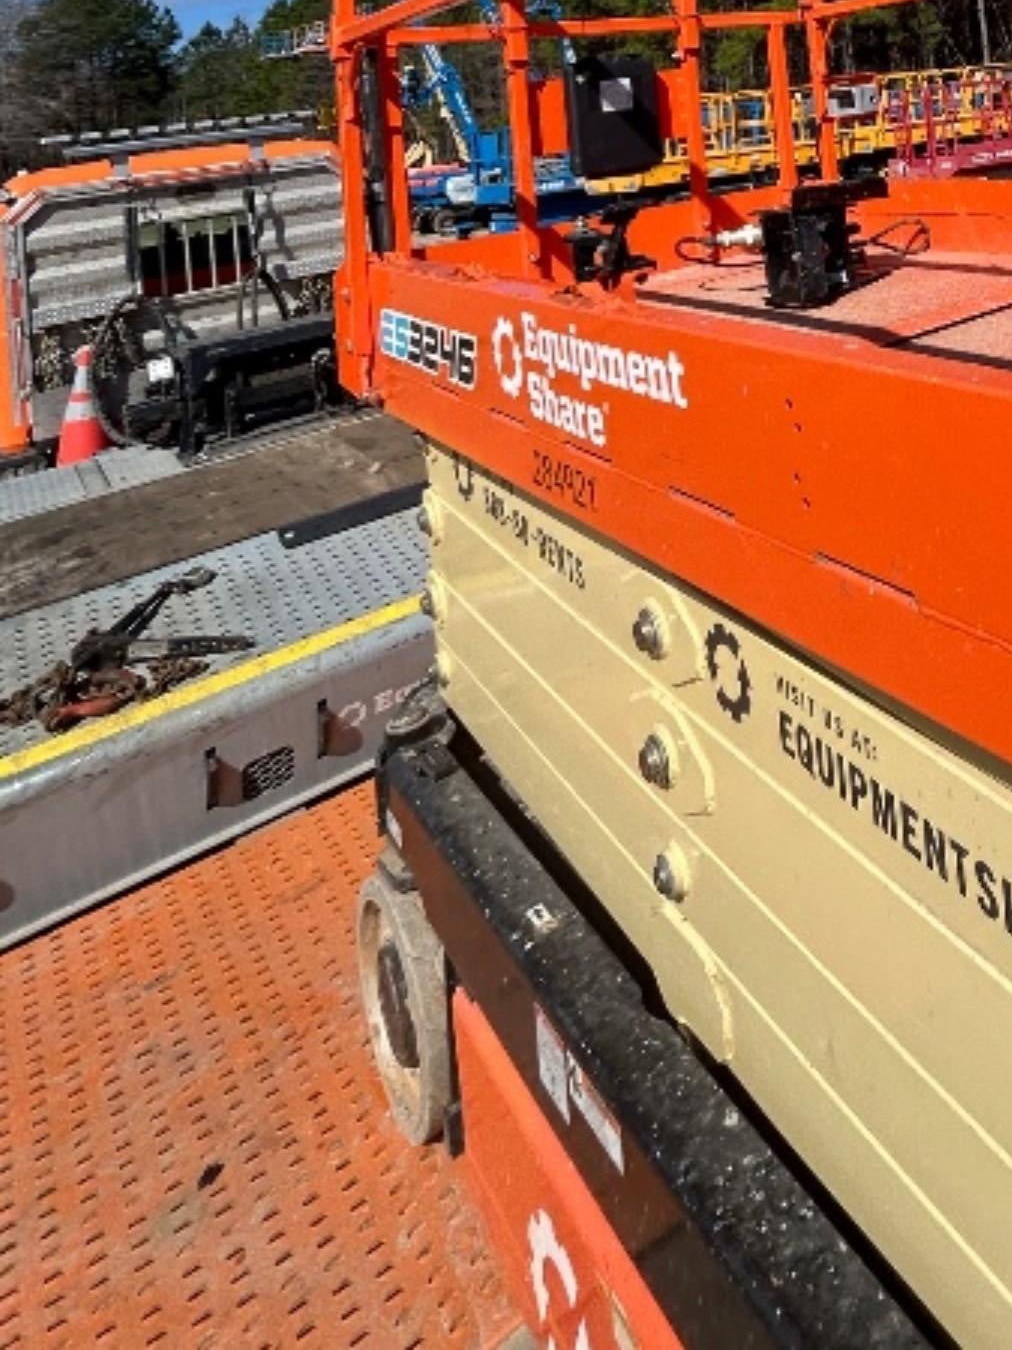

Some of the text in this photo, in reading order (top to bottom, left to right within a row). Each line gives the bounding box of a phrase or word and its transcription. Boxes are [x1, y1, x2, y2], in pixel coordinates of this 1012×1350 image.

[380, 308, 477, 392] ES3246
[521, 311, 689, 410] Equipment
[526, 372, 607, 448] Share
[532, 449, 598, 512] 284921
[775, 673, 815, 718] VISIT
[822, 708, 844, 739] US
